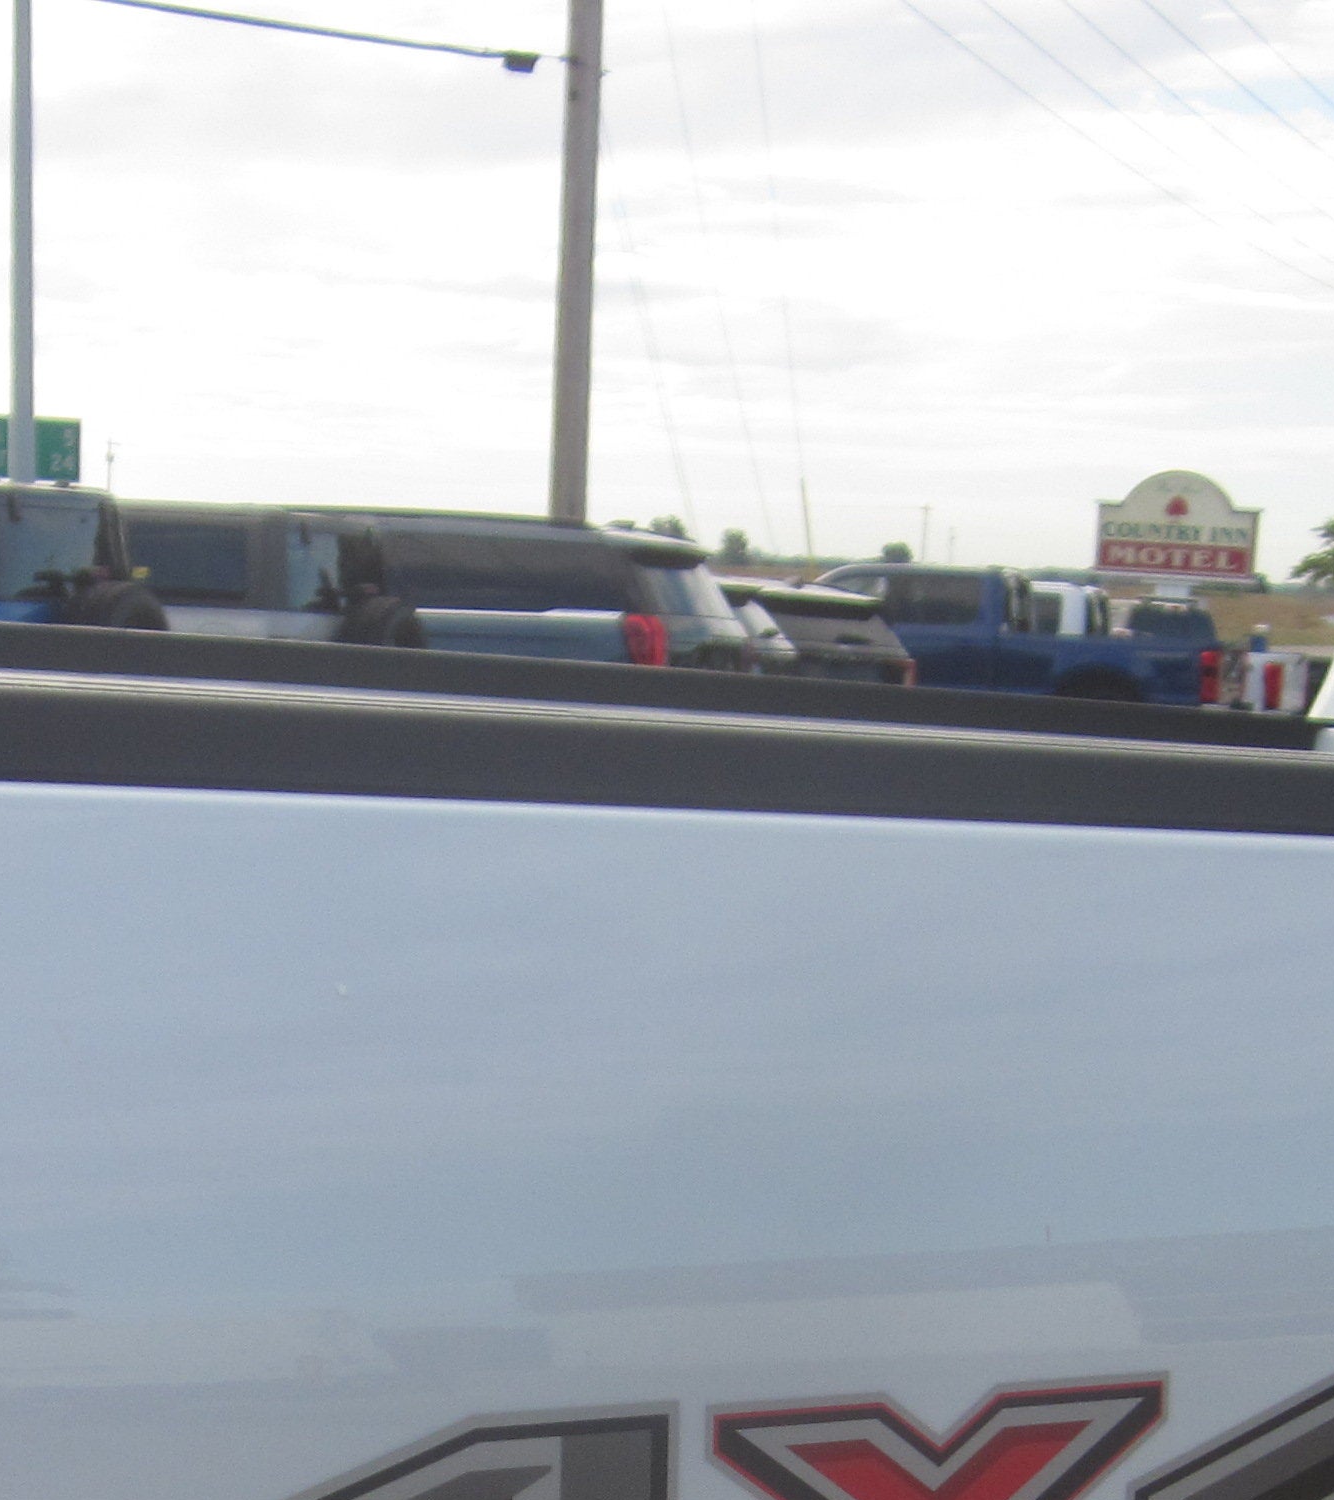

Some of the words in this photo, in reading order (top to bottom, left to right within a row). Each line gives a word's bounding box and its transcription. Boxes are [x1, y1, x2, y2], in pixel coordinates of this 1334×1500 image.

[1103, 521, 1201, 541] COUNTRY
[1211, 527, 1249, 544] INN
[1107, 544, 1238, 569] MOTEL
